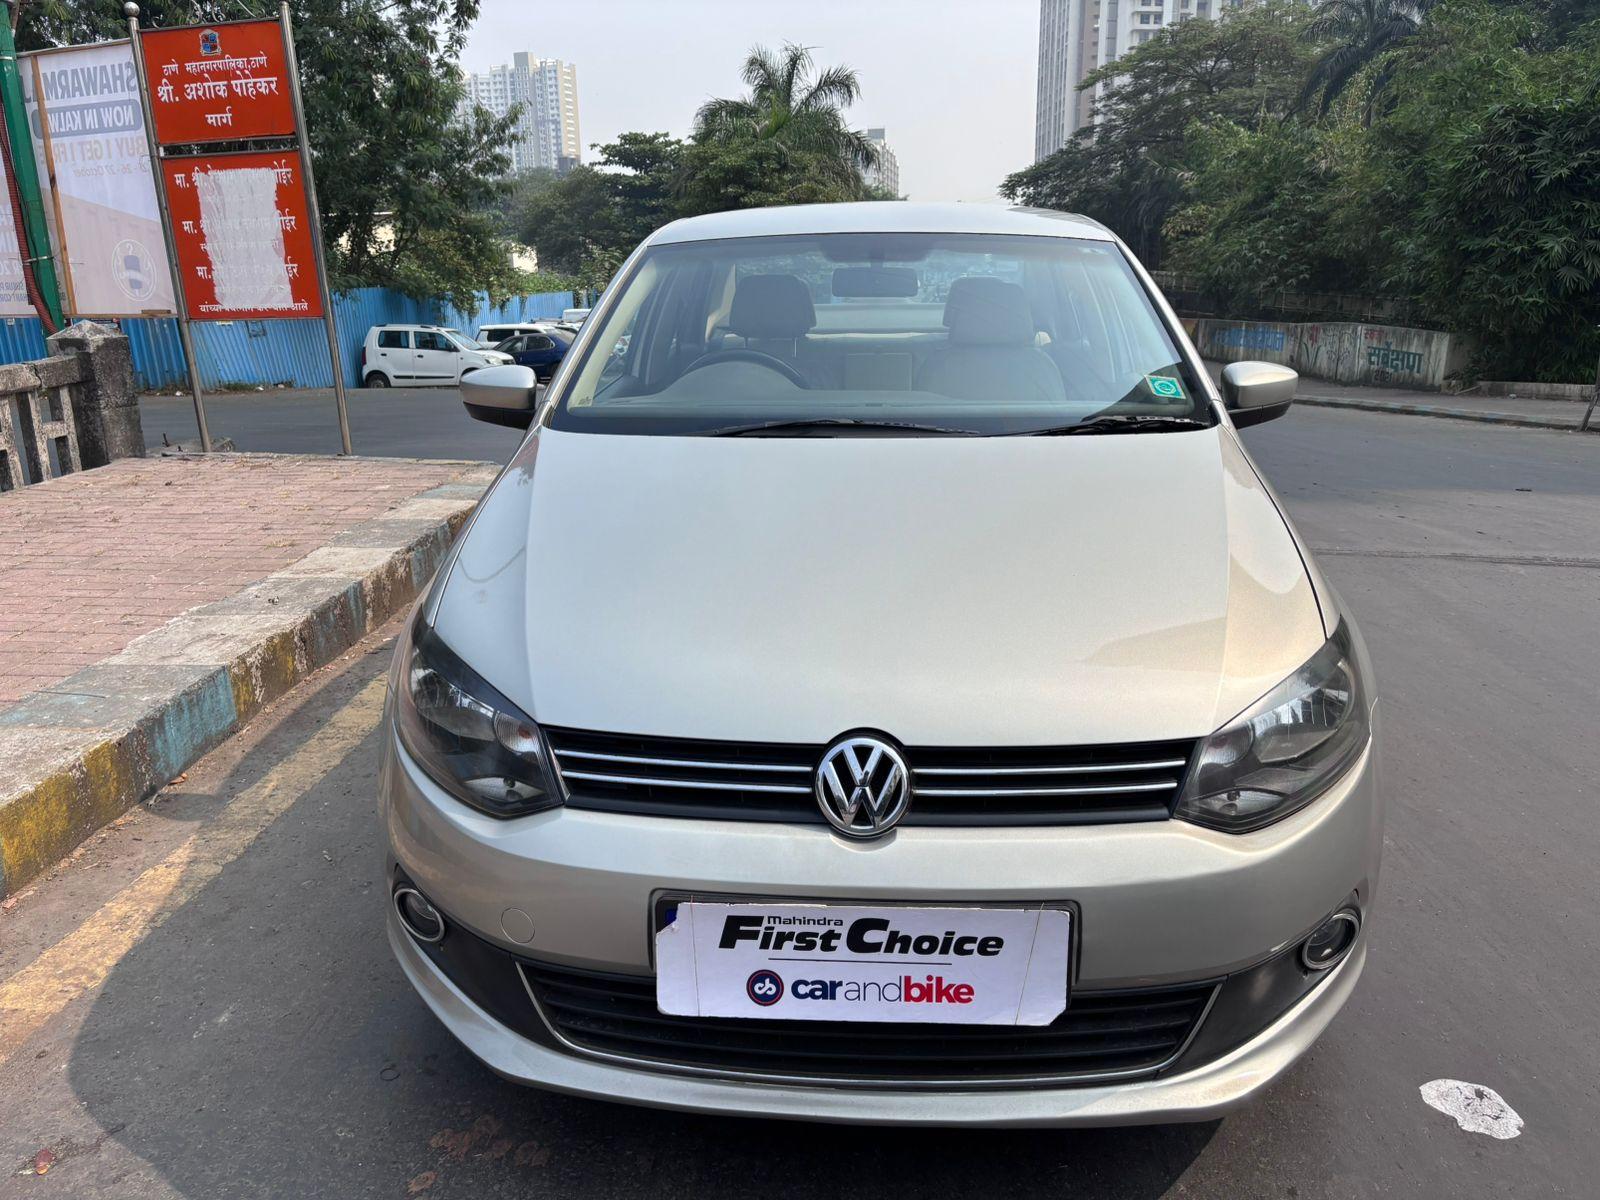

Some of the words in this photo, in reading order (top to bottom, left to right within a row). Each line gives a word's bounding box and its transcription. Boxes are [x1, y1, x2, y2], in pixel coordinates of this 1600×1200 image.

[162, 59, 179, 76] ठाणे
[157, 78, 180, 103] श्री.
[184, 73, 228, 100] अशोक
[230, 70, 279, 100] पोहेकर
[205, 106, 233, 127] मार्ग
[173, 173, 190, 189] मा.
[182, 220, 198, 235] मा.
[195, 266, 212, 280] मा.
[1367, 340, 1424, 373] सर्वेक्षण
[820, 741, 906, 831] VW
[767, 915, 844, 927] Mahindra
[719, 915, 842, 952] First
[846, 917, 1004, 957] Choice
[790, 974, 975, 1004] carandbike
